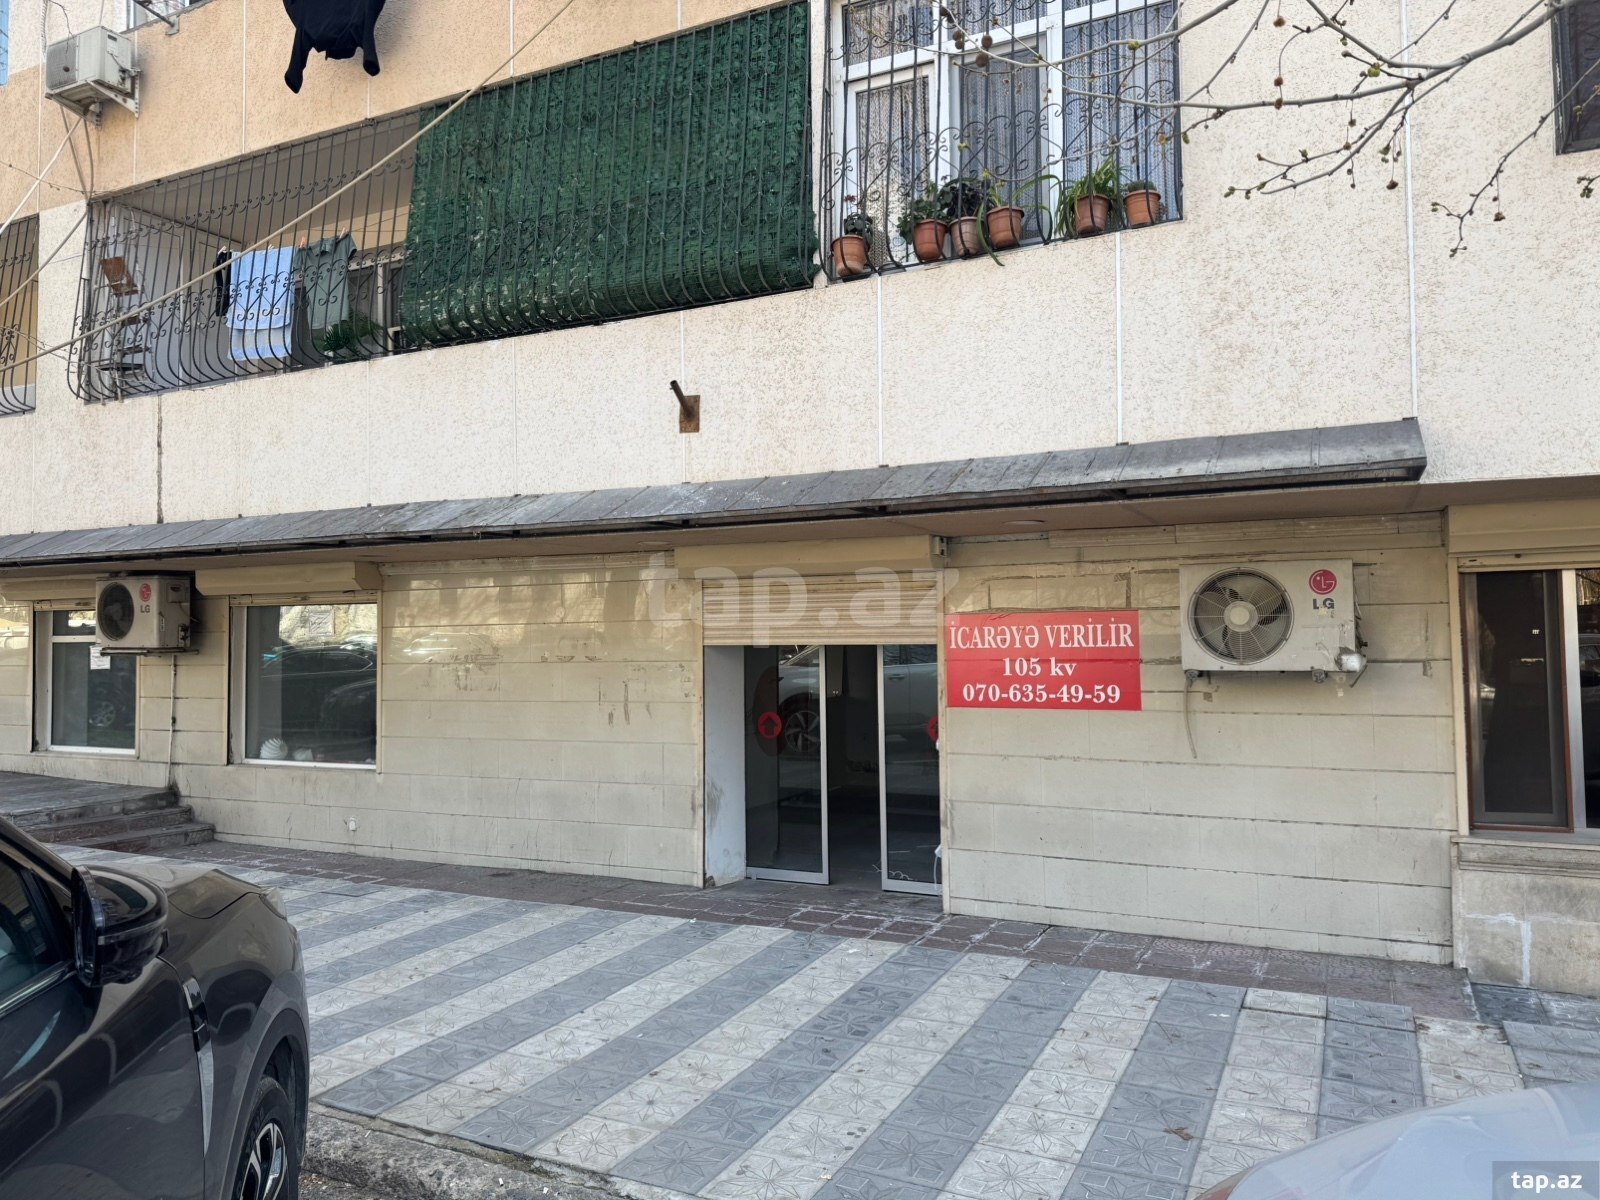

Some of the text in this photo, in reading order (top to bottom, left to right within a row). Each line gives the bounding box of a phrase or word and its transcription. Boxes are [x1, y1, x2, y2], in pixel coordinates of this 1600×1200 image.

[140, 604, 151, 613] LG
[1312, 597, 1335, 610] LG
[949, 617, 1135, 649] İCARƏYƏ VERİLİR
[1002, 656, 1078, 677] 105 kv
[962, 683, 1121, 704] 070-635-49-59
